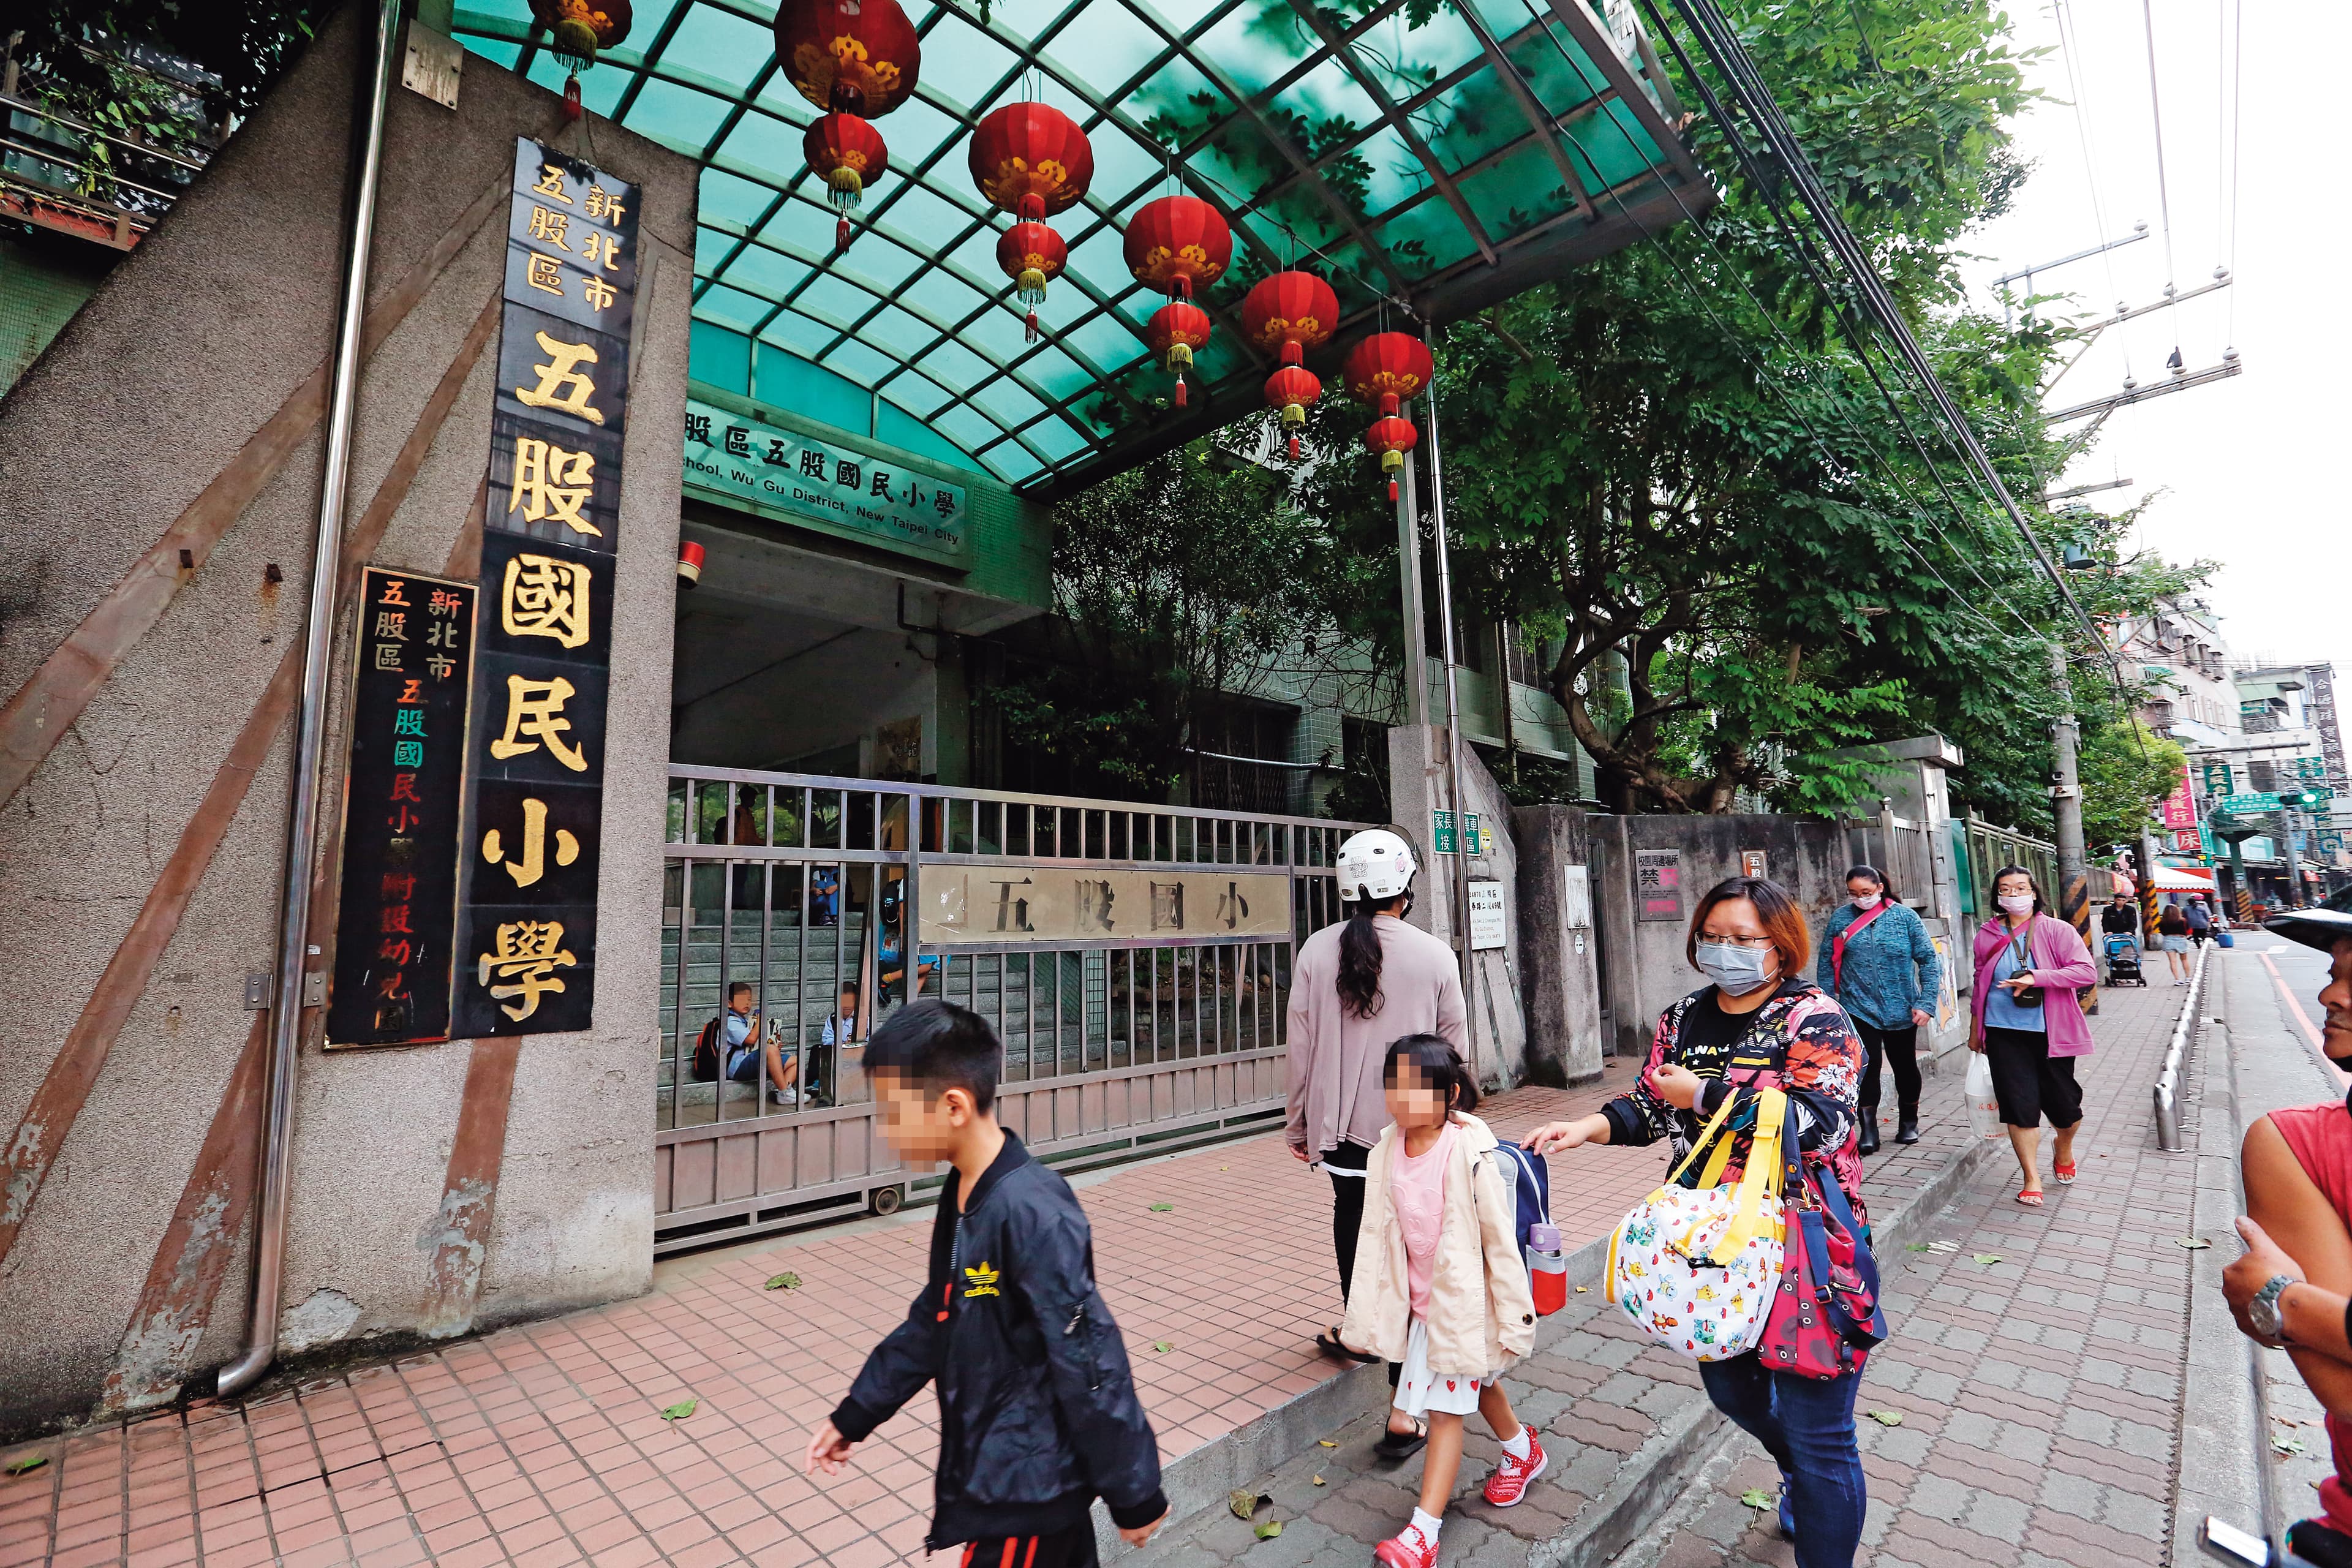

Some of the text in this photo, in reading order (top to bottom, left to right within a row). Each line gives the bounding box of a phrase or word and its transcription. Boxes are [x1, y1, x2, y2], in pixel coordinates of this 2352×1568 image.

[526, 164, 573, 296] 五股區
[582, 183, 626, 313] 新北市
[731, 469, 754, 486] Wu
[763, 480, 785, 495] Gu
[793, 488, 850, 515] District,
[856, 505, 884, 522] New
[891, 515, 928, 535] Taipei
[934, 529, 959, 545] City
[374, 581, 412, 673] 五股區
[426, 589, 463, 684] 新北市
[478, 330, 605, 1023] 五股國民小學
[1440, 834, 1475, 853] 接區
[964, 1284, 1000, 1298] adidas
